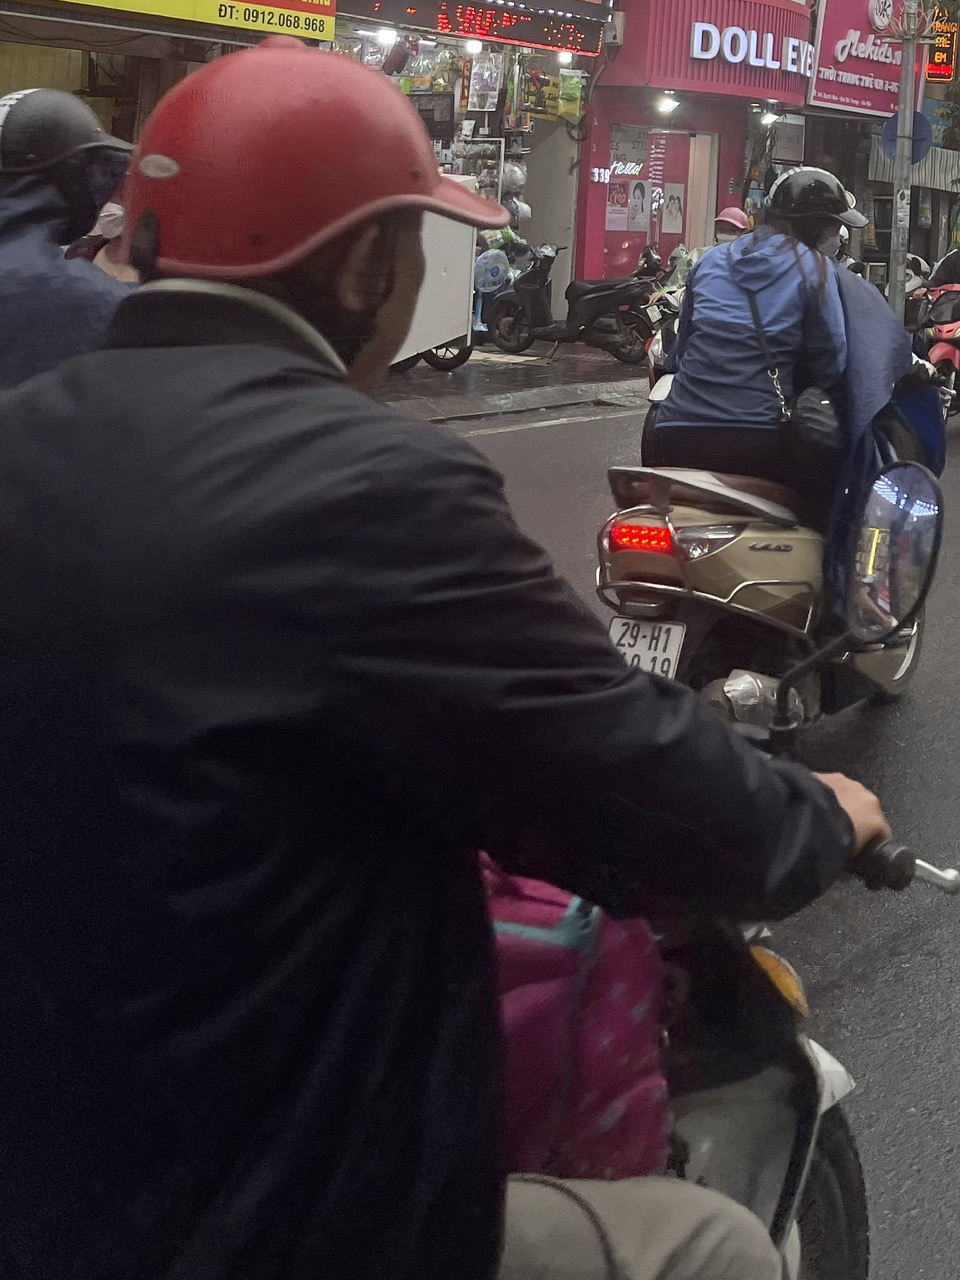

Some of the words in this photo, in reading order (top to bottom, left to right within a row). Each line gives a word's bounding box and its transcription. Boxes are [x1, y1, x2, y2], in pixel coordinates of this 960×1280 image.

[218, 4, 239, 20] ĐT:
[243, 8, 325, 33] 0912.068.968
[783, 37, 815, 77] EYE
[616, 622, 671, 653] 29-H1
